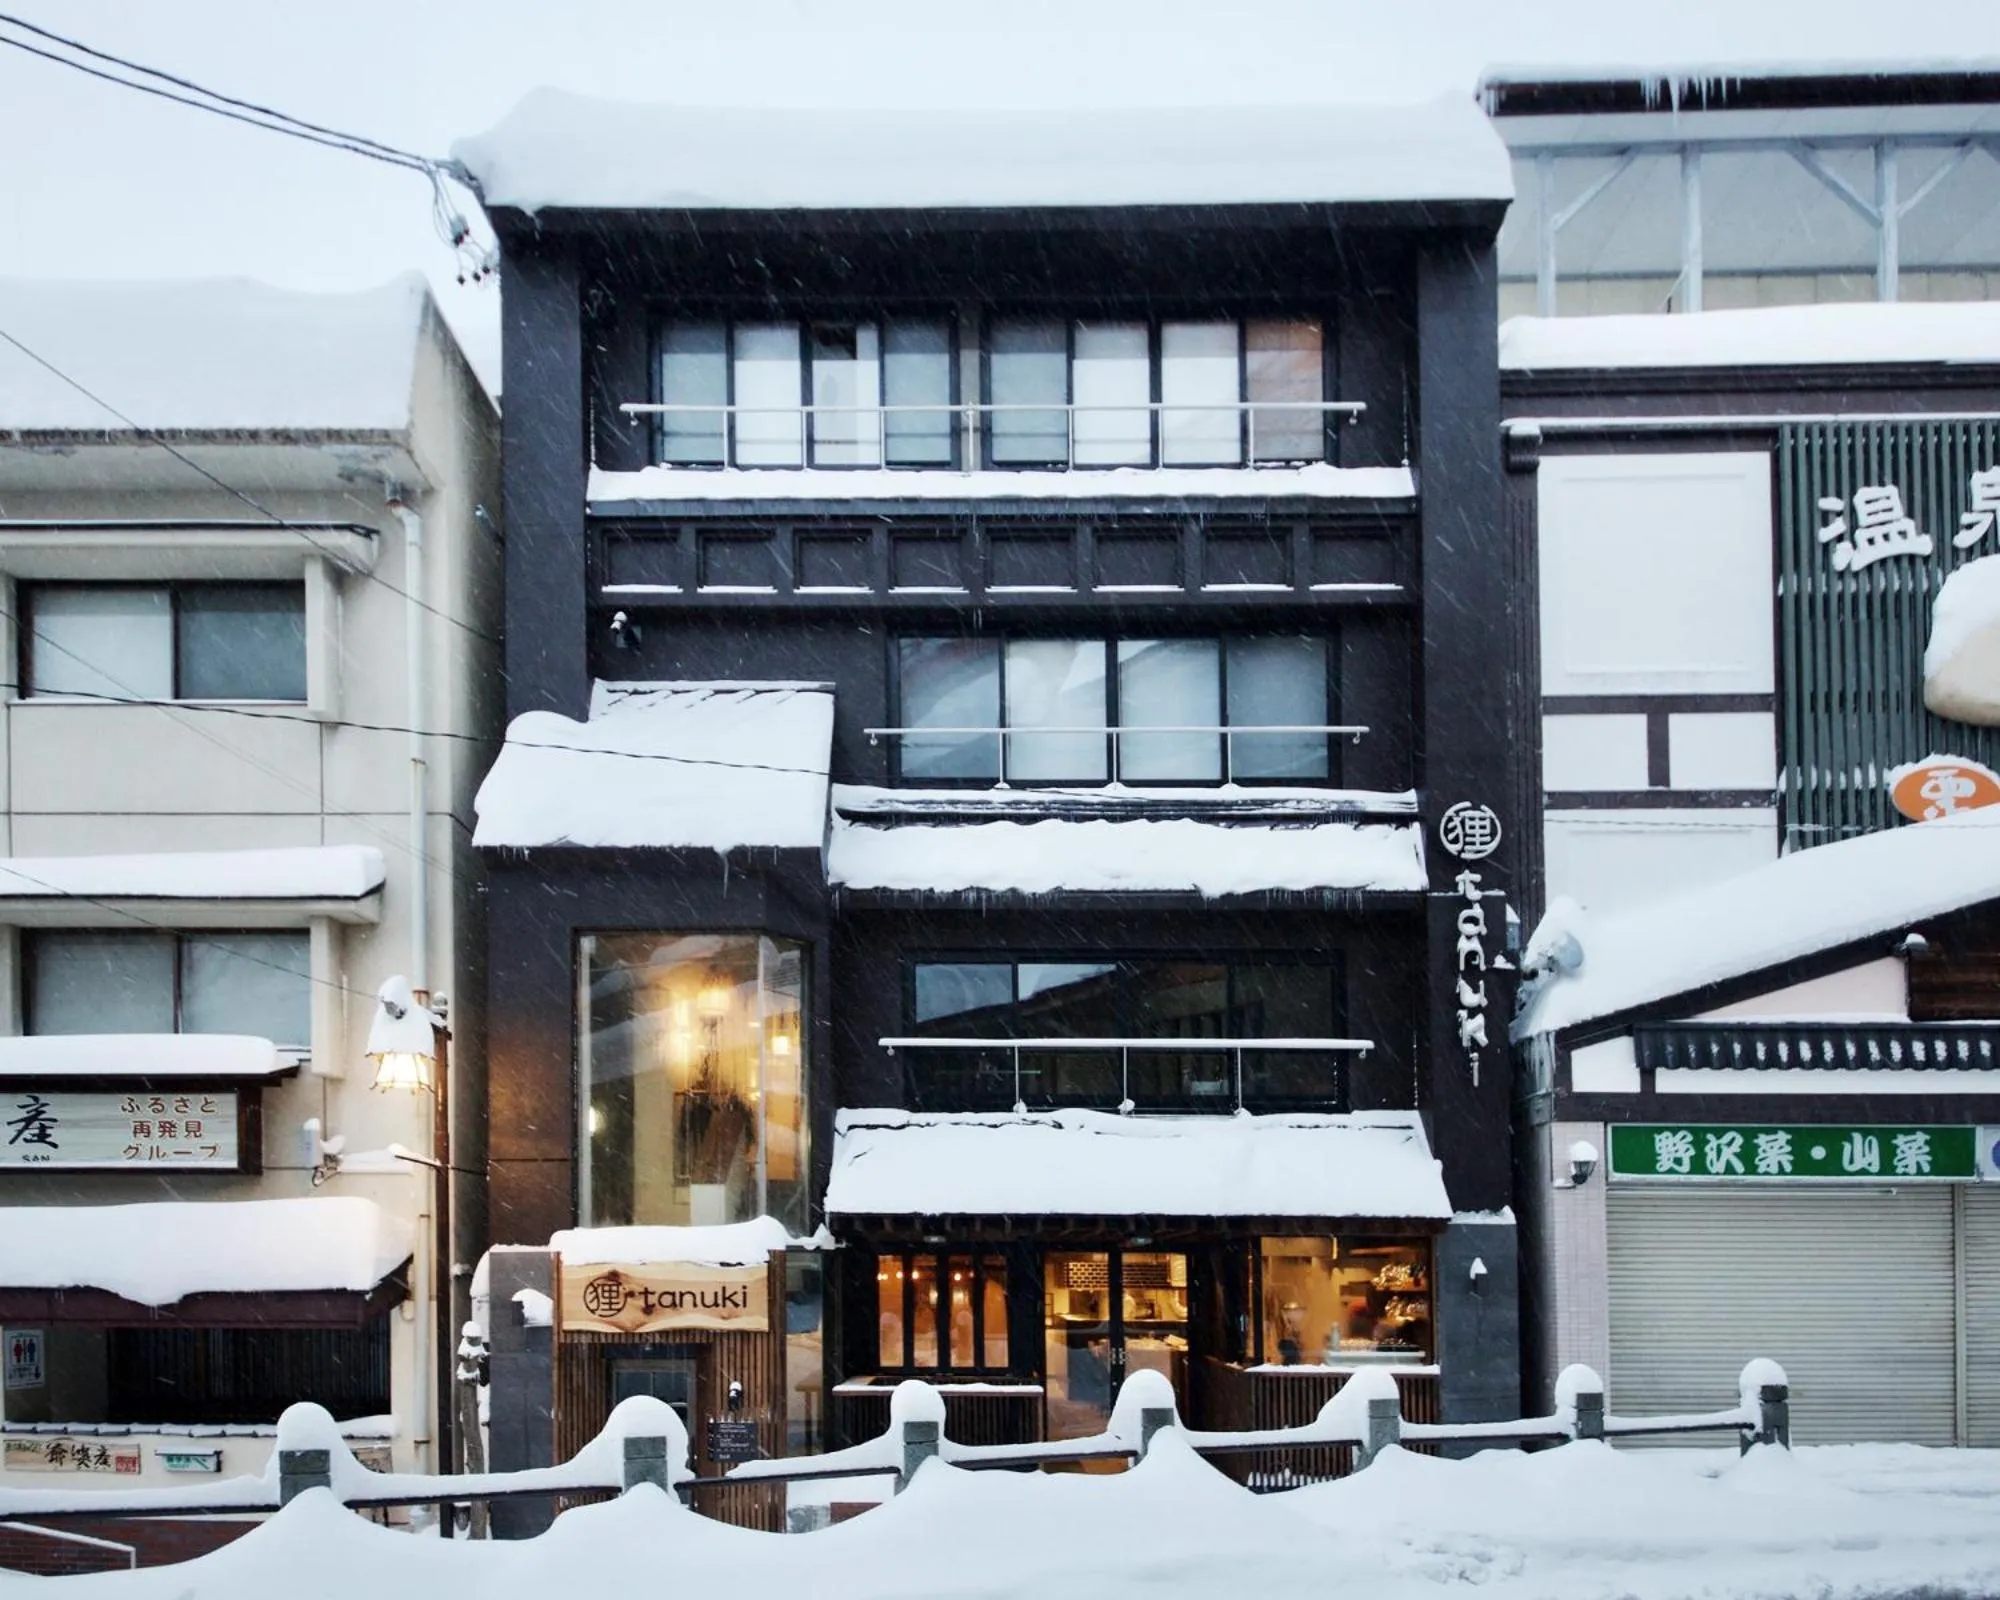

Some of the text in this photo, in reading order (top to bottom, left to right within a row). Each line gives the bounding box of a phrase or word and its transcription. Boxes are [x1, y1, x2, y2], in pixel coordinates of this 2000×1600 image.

[1455, 869, 1488, 1087] tanuki
[121, 1097, 216, 1114] ふるさと
[132, 1120, 203, 1138] 再発見
[638, 1285, 748, 1309] tanuki
